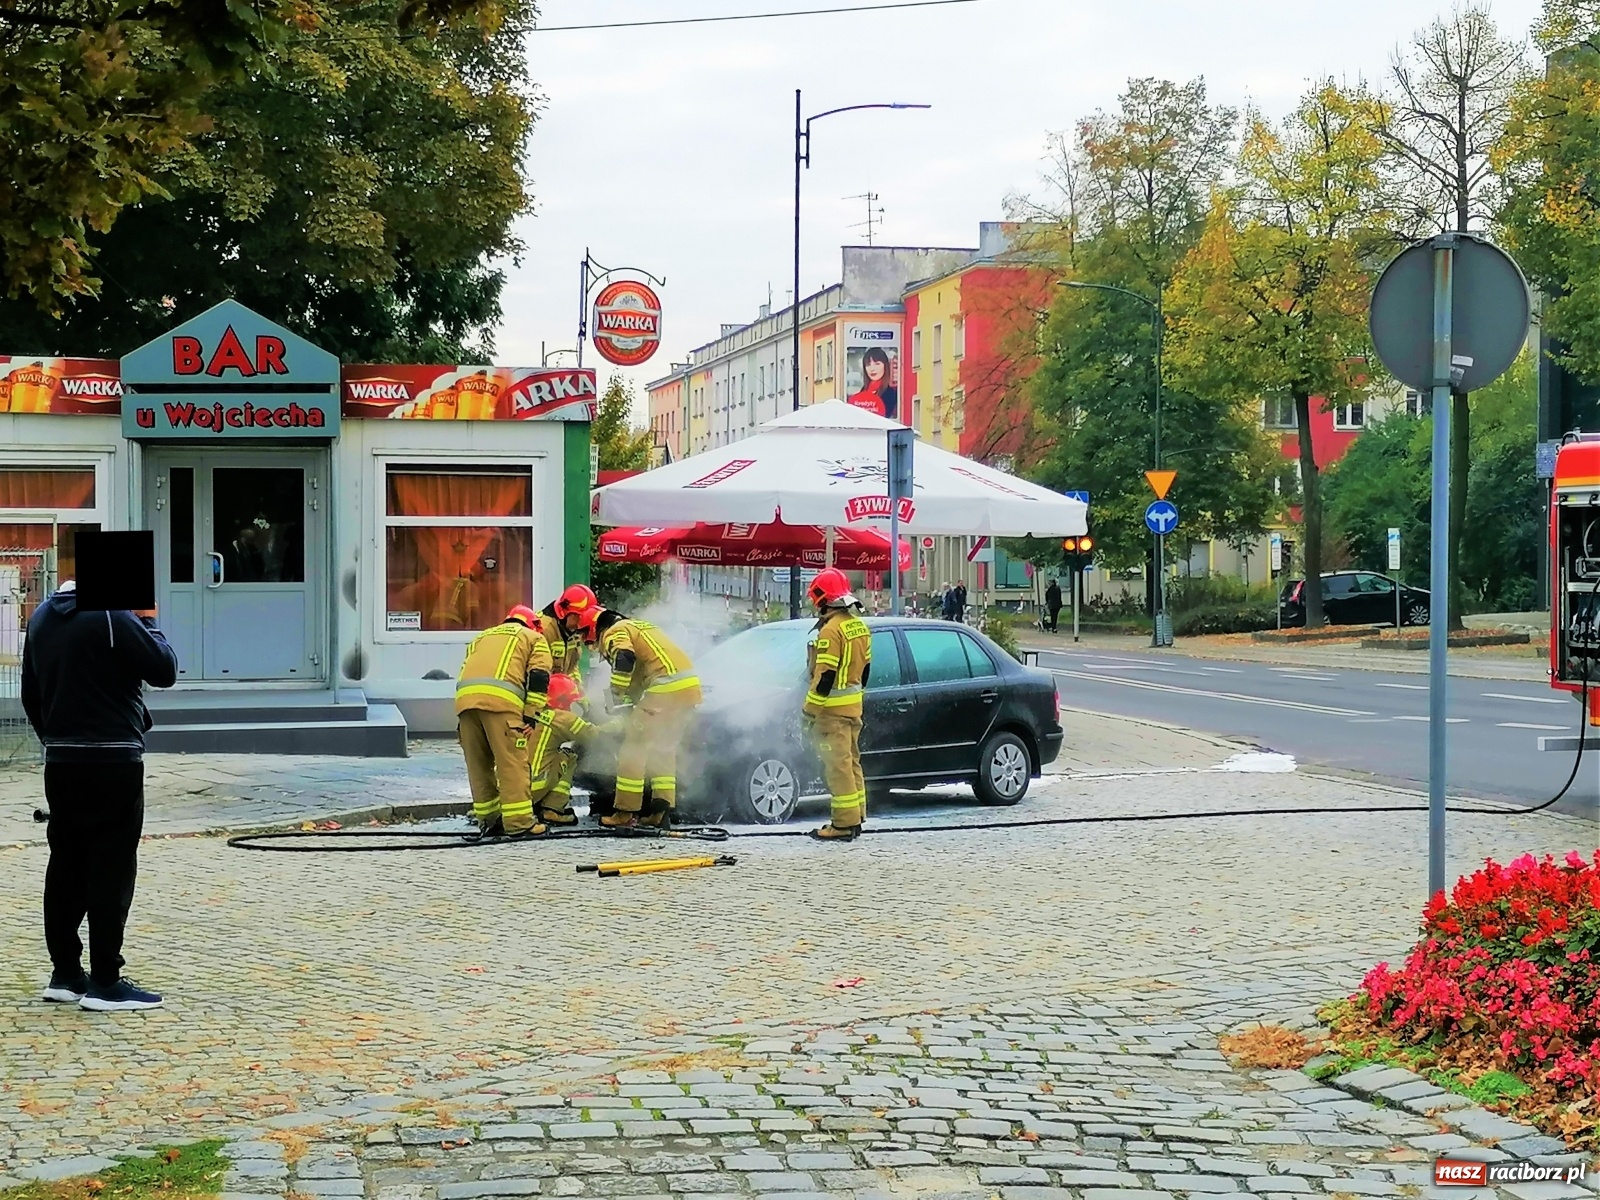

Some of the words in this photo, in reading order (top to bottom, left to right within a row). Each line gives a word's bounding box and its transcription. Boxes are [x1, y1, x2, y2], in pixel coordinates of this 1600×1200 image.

[601, 314, 655, 331] WARKA
[173, 324, 289, 377] BAR
[17, 373, 54, 386] WARKA
[62, 379, 124, 396] WARKA
[463, 381, 498, 395] WARKA
[349, 384, 410, 399] WARKA
[136, 408, 156, 428] u
[163, 401, 325, 433] Wojciecha
[854, 497, 908, 515] ŻYWIC
[680, 547, 718, 559] WARKA
[746, 548, 782, 561] Classic
[856, 552, 886, 565] Classic
